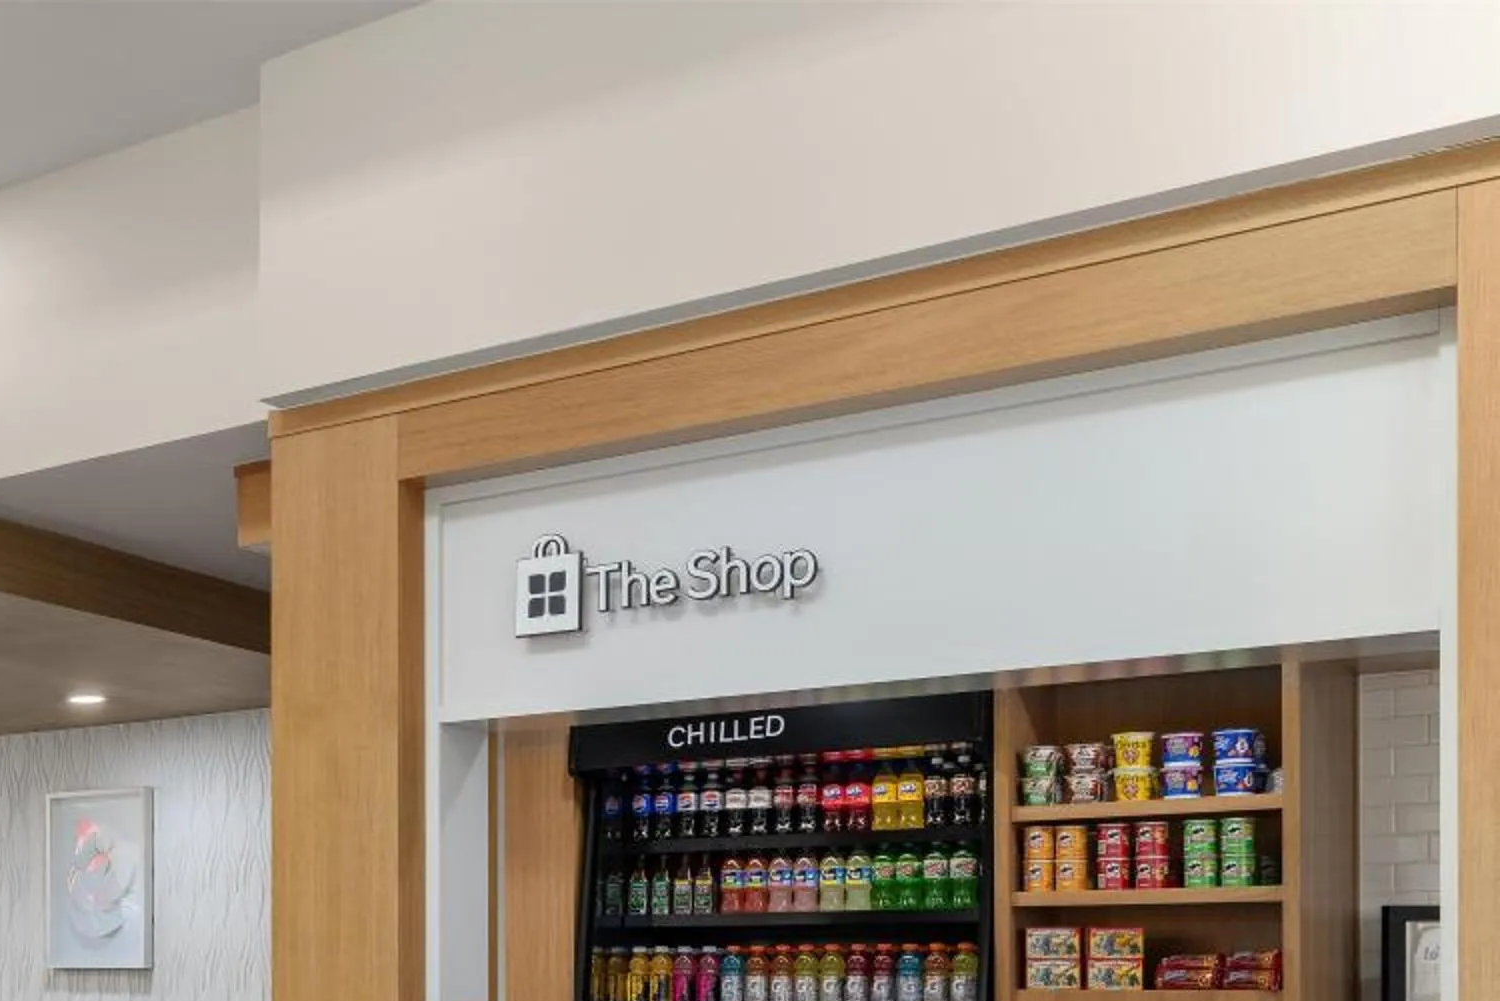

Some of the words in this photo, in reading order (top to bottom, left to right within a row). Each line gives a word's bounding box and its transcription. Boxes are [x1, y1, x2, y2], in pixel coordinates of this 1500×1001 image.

[586, 559, 680, 612] The
[686, 546, 819, 600] Shop
[667, 714, 785, 748] CHILLED
